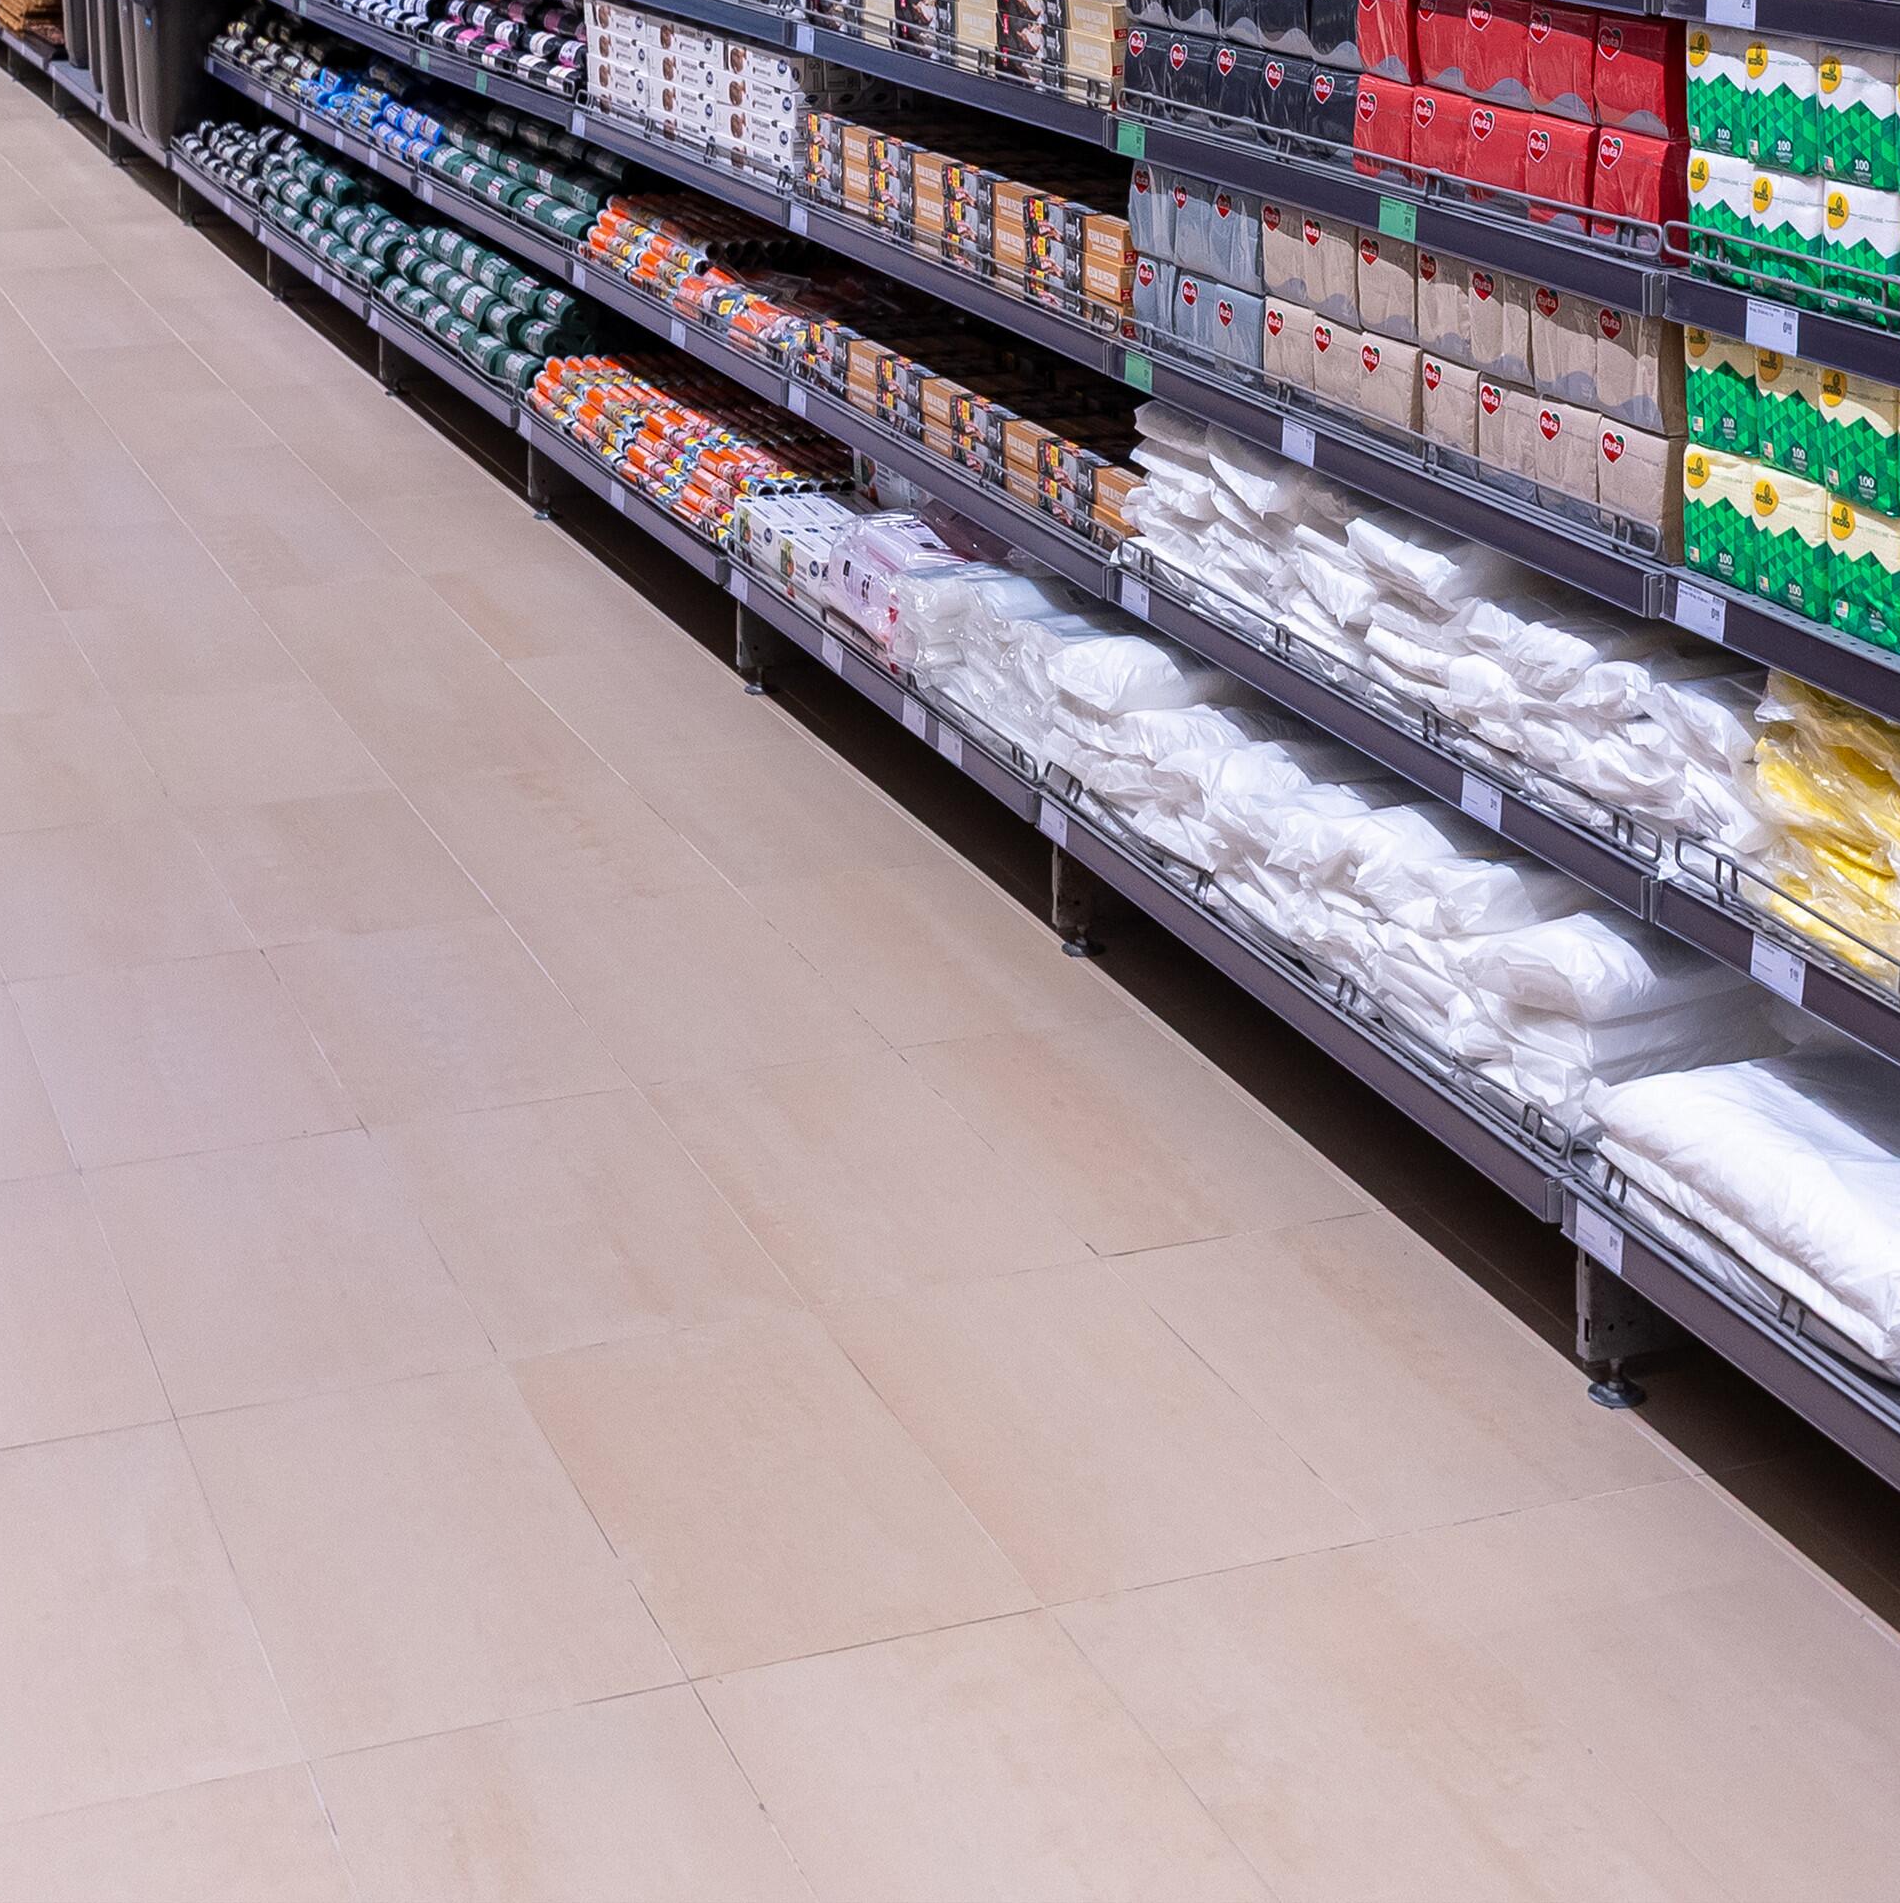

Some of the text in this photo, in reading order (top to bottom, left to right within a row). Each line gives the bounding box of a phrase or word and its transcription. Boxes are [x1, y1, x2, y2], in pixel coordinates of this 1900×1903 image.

[1359, 99, 1375, 113] Ruta
[1416, 105, 1433, 120] Ruta
[1473, 117, 1492, 132] Ruta
[1717, 128, 1730, 139] 100
[1529, 138, 1549, 153] Ruta
[1601, 144, 1621, 159] Ruta
[1777, 140, 1791, 152] 100
[1854, 159, 1869, 171] 100
[1723, 418, 1735, 429] 100
[1602, 439, 1623, 454] Ruta
[1792, 447, 1805, 460] 100
[1859, 475, 1874, 488] 100
[1719, 553, 1732, 565] 100
[1788, 584, 1802, 597] 100
